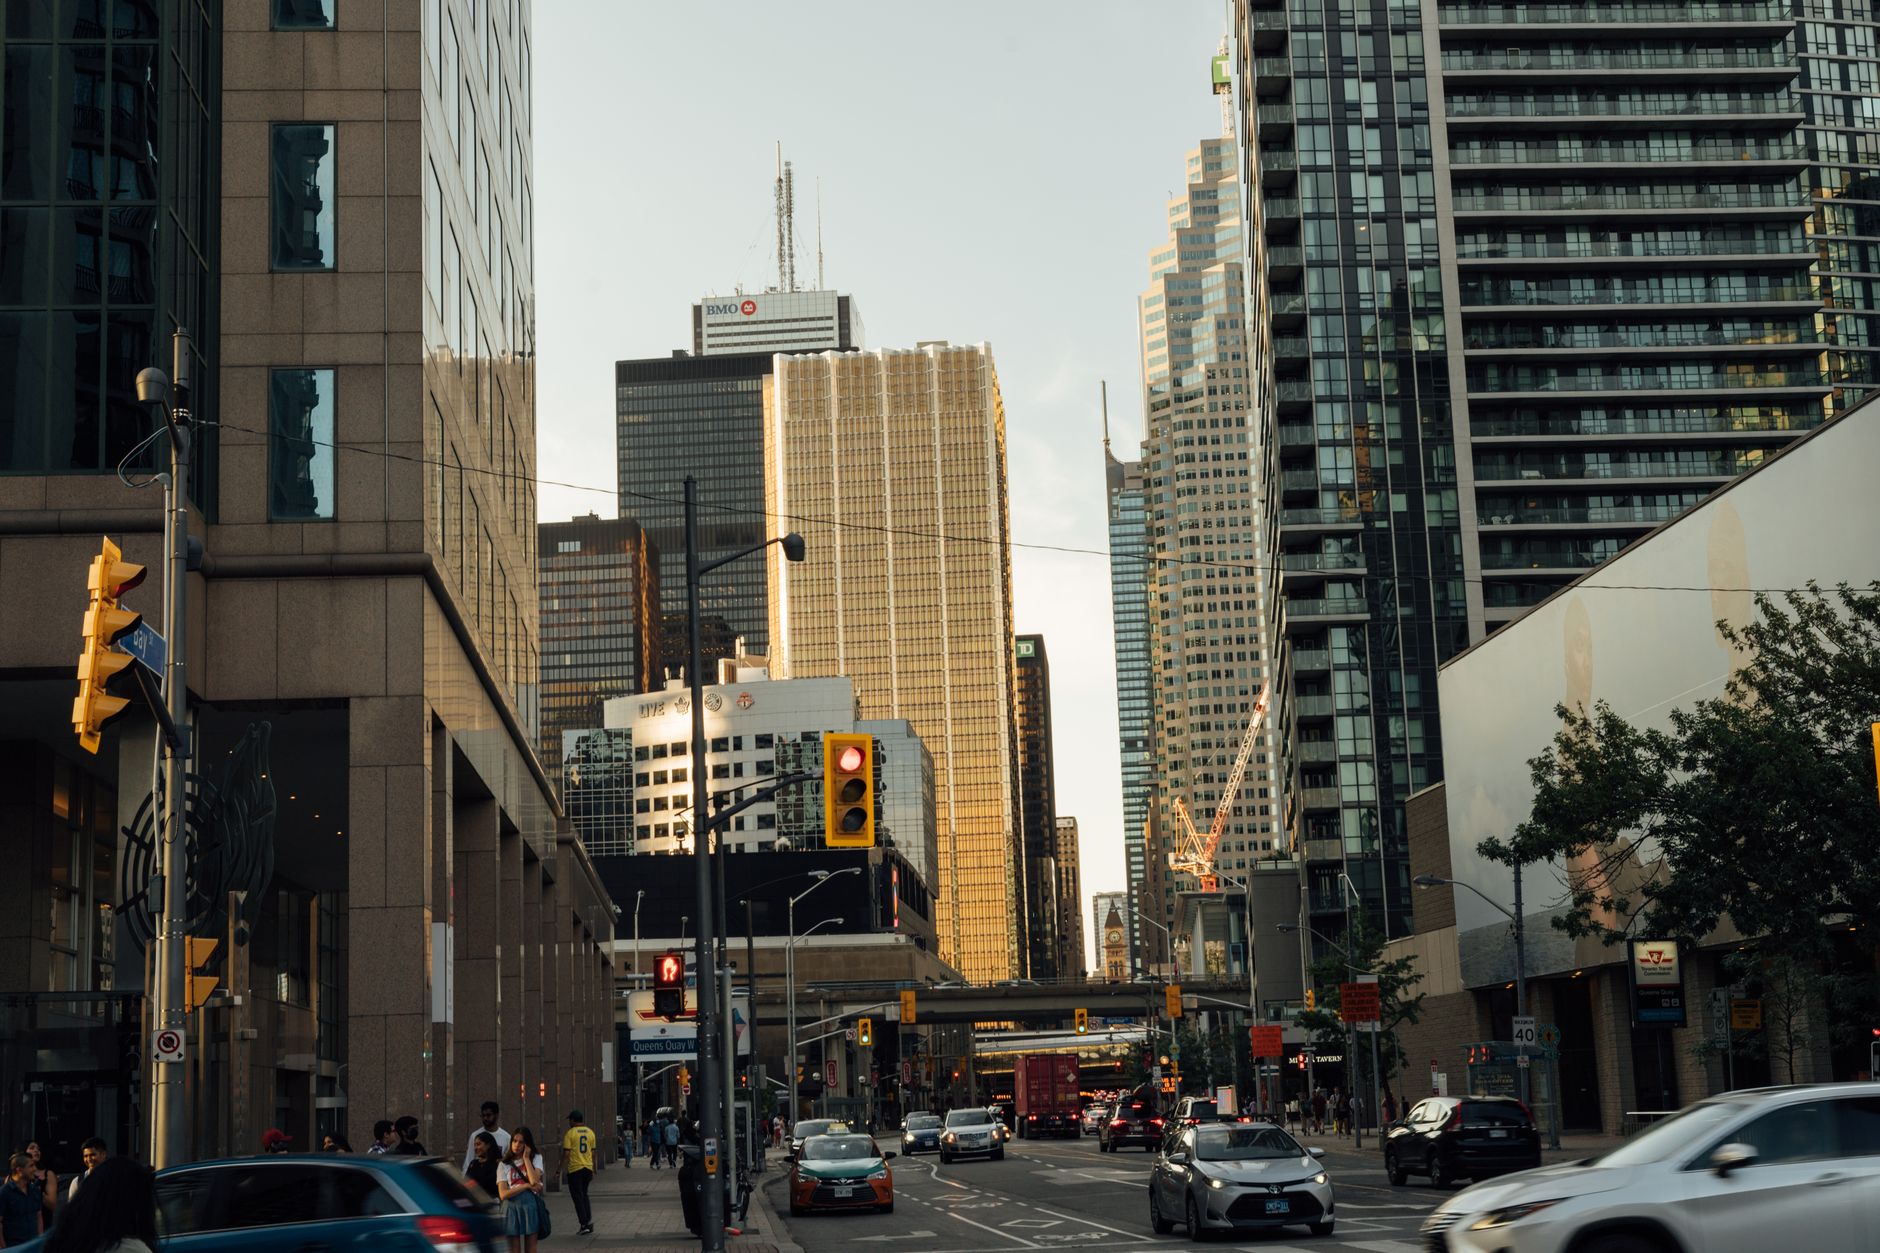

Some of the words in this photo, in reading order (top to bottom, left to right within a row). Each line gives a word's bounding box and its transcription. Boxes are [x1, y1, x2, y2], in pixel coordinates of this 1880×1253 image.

[707, 303, 738, 316] BMO
[133, 628, 148, 660] Bay
[1017, 643, 1033, 655] TD
[639, 701, 664, 719] LIVE
[1515, 1028, 1534, 1042] 40
[633, 1041, 664, 1052] Queens
[665, 1041, 686, 1053] Quay
[687, 1040, 695, 1050] W
[1315, 1055, 1343, 1063] TAVERN
[579, 1135, 588, 1154] 6
